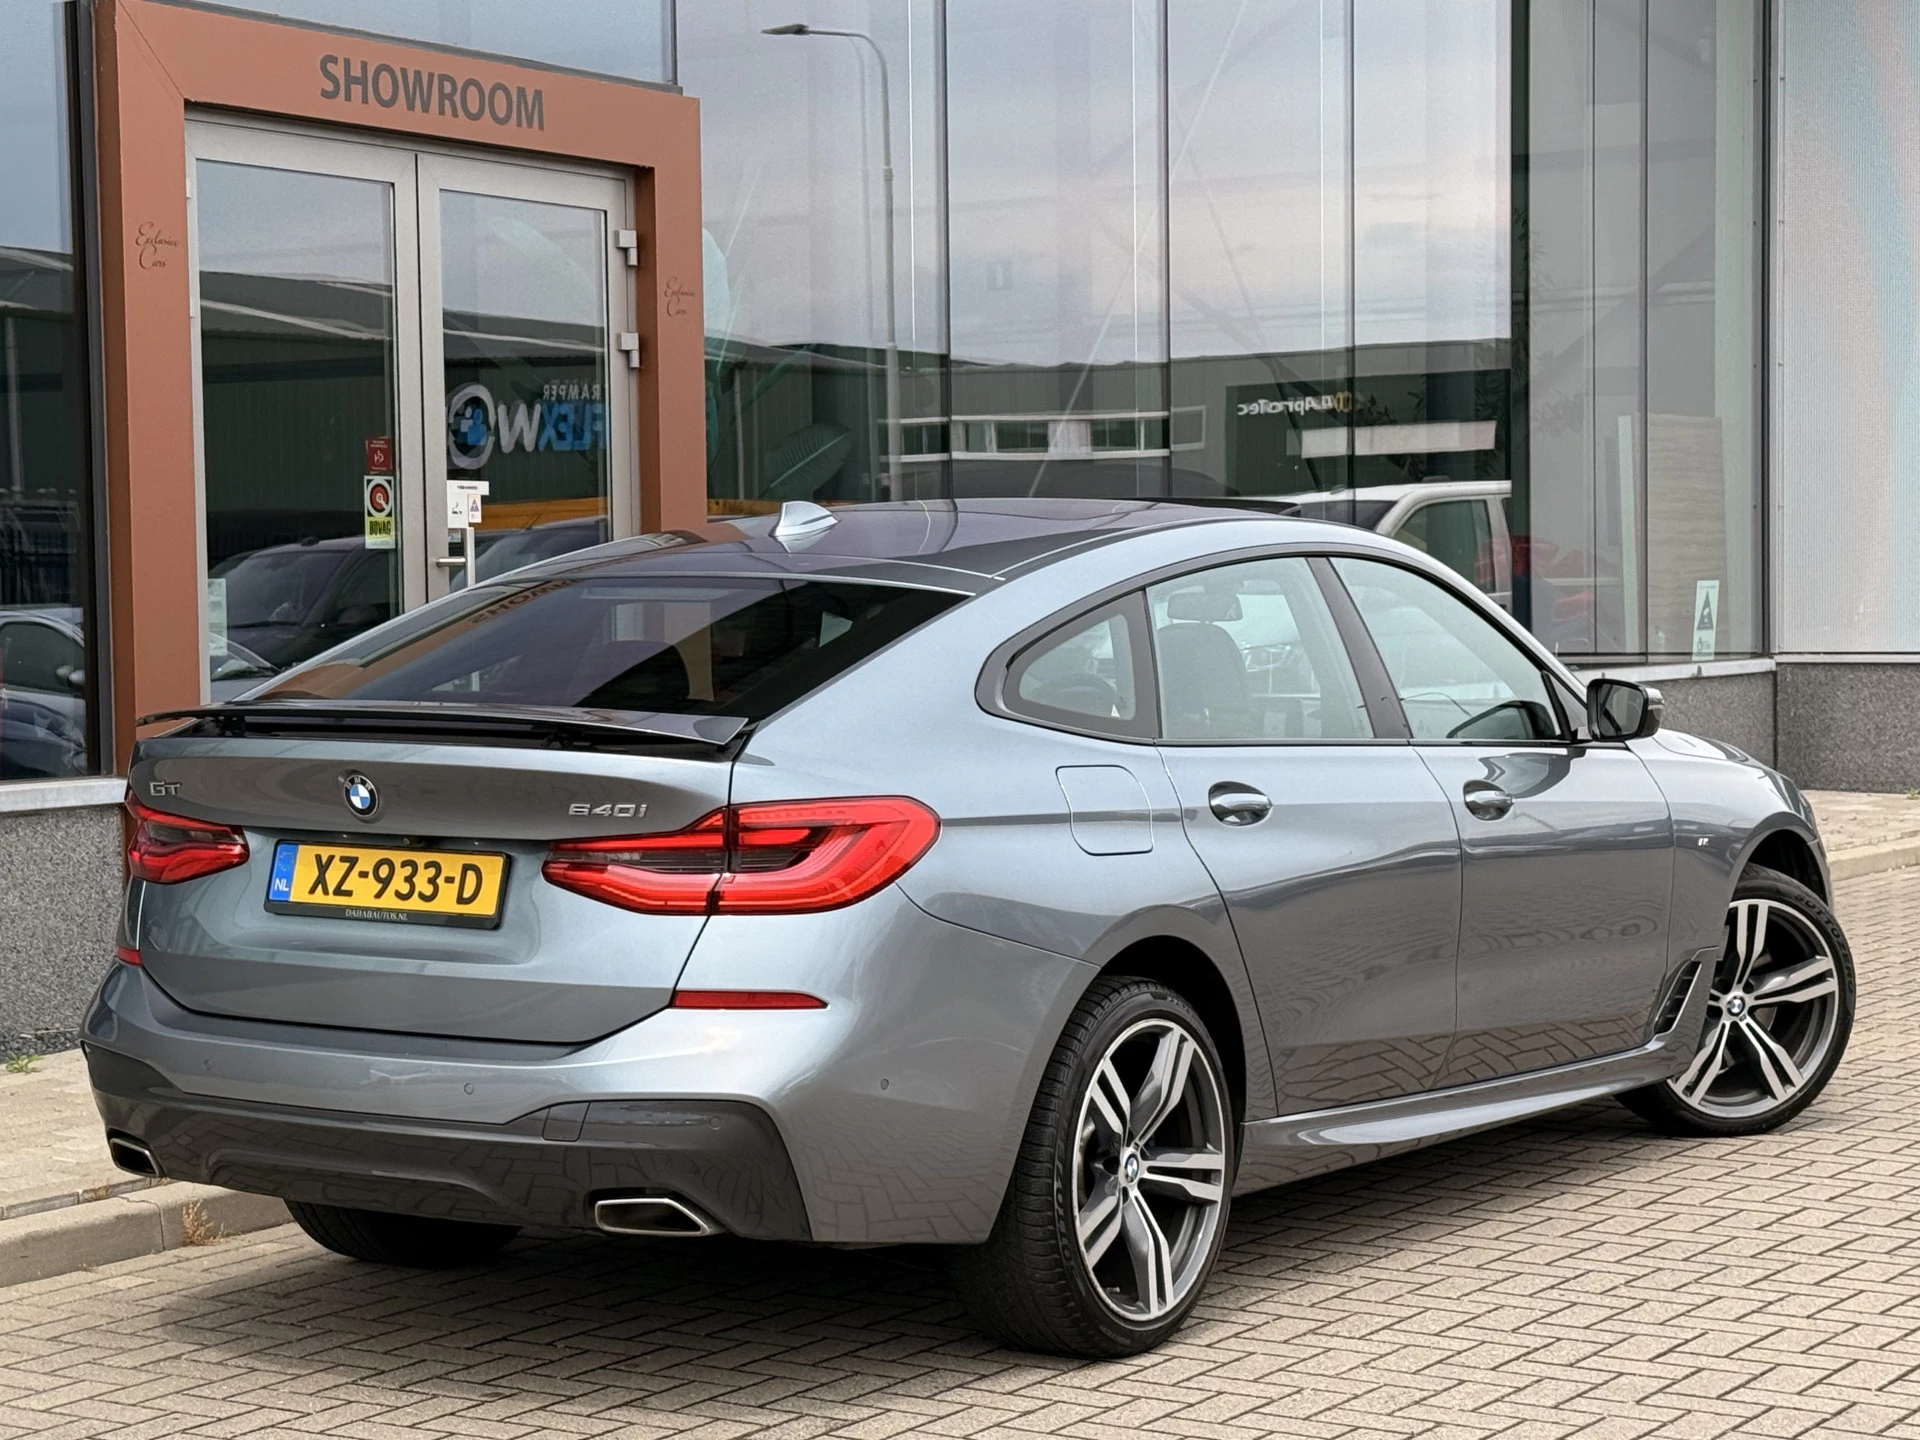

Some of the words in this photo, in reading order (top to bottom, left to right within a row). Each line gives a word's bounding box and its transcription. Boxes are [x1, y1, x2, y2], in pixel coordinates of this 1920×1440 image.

[319, 54, 545, 132] SHOWROOM
[150, 780, 181, 796] GT
[568, 803, 648, 818] 640i
[273, 876, 290, 892] NL
[308, 853, 483, 905] XZ-933-D
